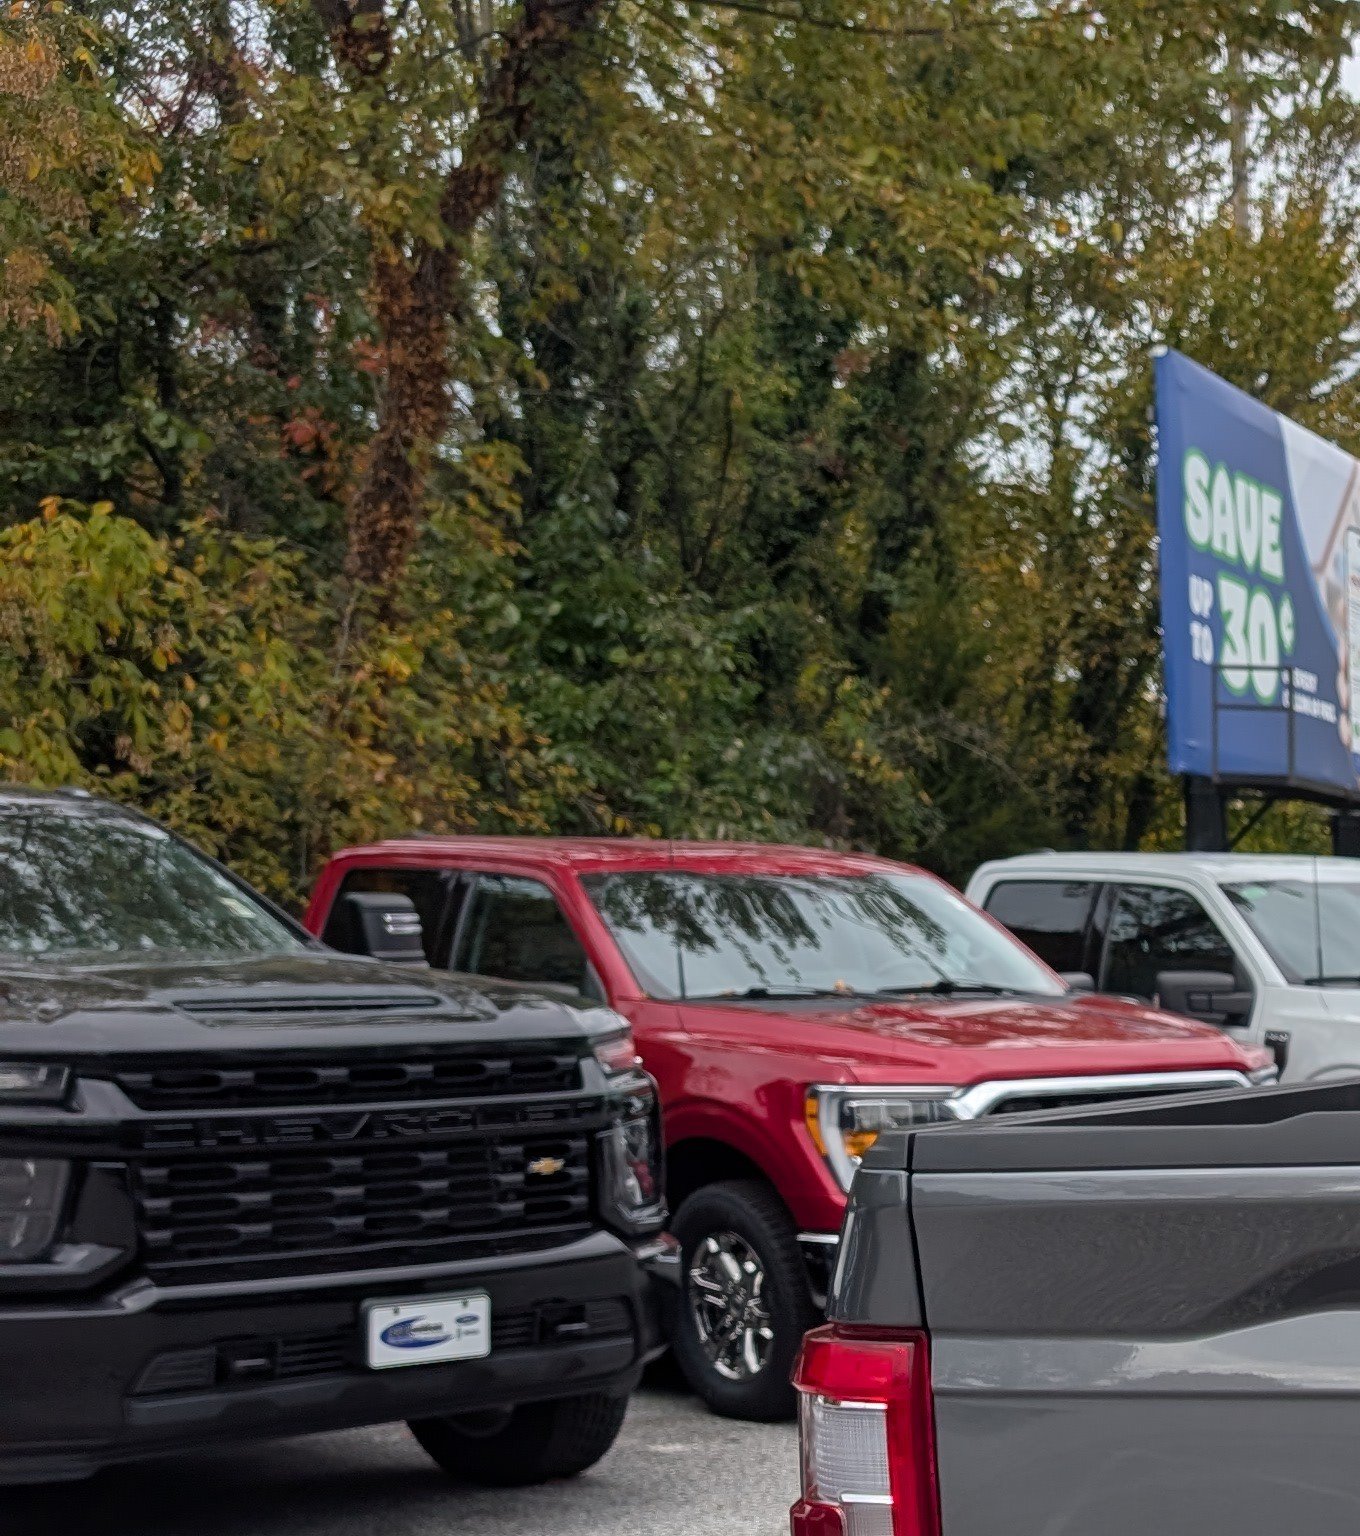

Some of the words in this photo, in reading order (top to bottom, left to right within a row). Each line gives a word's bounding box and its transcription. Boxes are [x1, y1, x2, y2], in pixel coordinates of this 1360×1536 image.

[1184, 453, 1284, 579] SAVE
[1189, 573, 1213, 619] UP
[1190, 620, 1213, 665] TO
